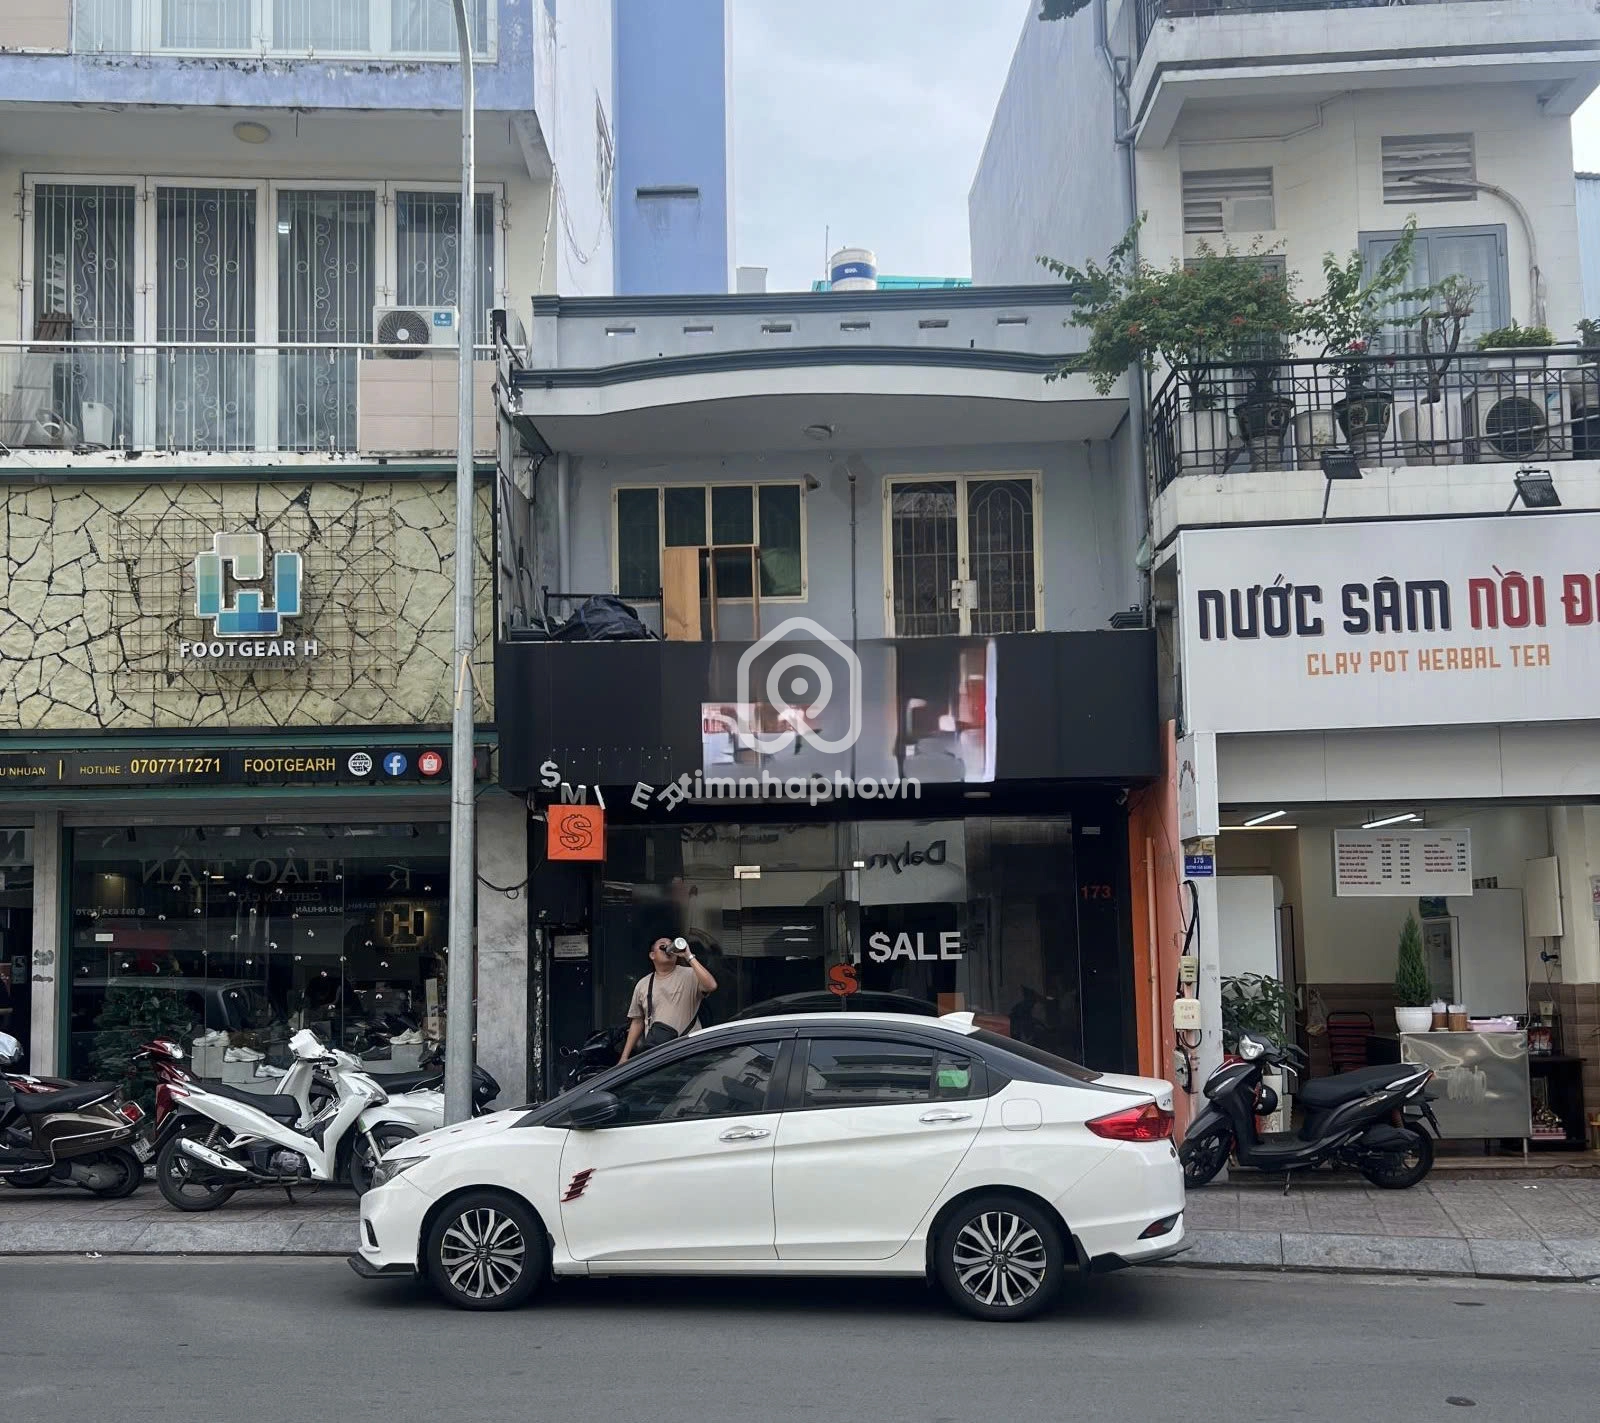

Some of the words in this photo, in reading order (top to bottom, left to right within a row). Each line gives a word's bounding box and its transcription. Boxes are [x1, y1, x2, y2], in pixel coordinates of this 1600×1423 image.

[1198, 573, 1325, 641] NƯỚC
[1341, 576, 1451, 633] SÂM
[1468, 565, 1546, 630] NỒI
[1560, 570, 1600, 627] Đ
[180, 641, 296, 657] FOOTGEAR
[304, 641, 318, 656] H
[1307, 651, 1361, 676] CLAY
[1370, 650, 1409, 673] POT
[1418, 646, 1502, 672] HERBAL
[1509, 644, 1551, 668] TEA
[80, 765, 121, 774] HOTLINE
[130, 758, 220, 773] 0707717271
[244, 758, 336, 772] FOOTGEARH
[1080, 885, 1111, 899] 173
